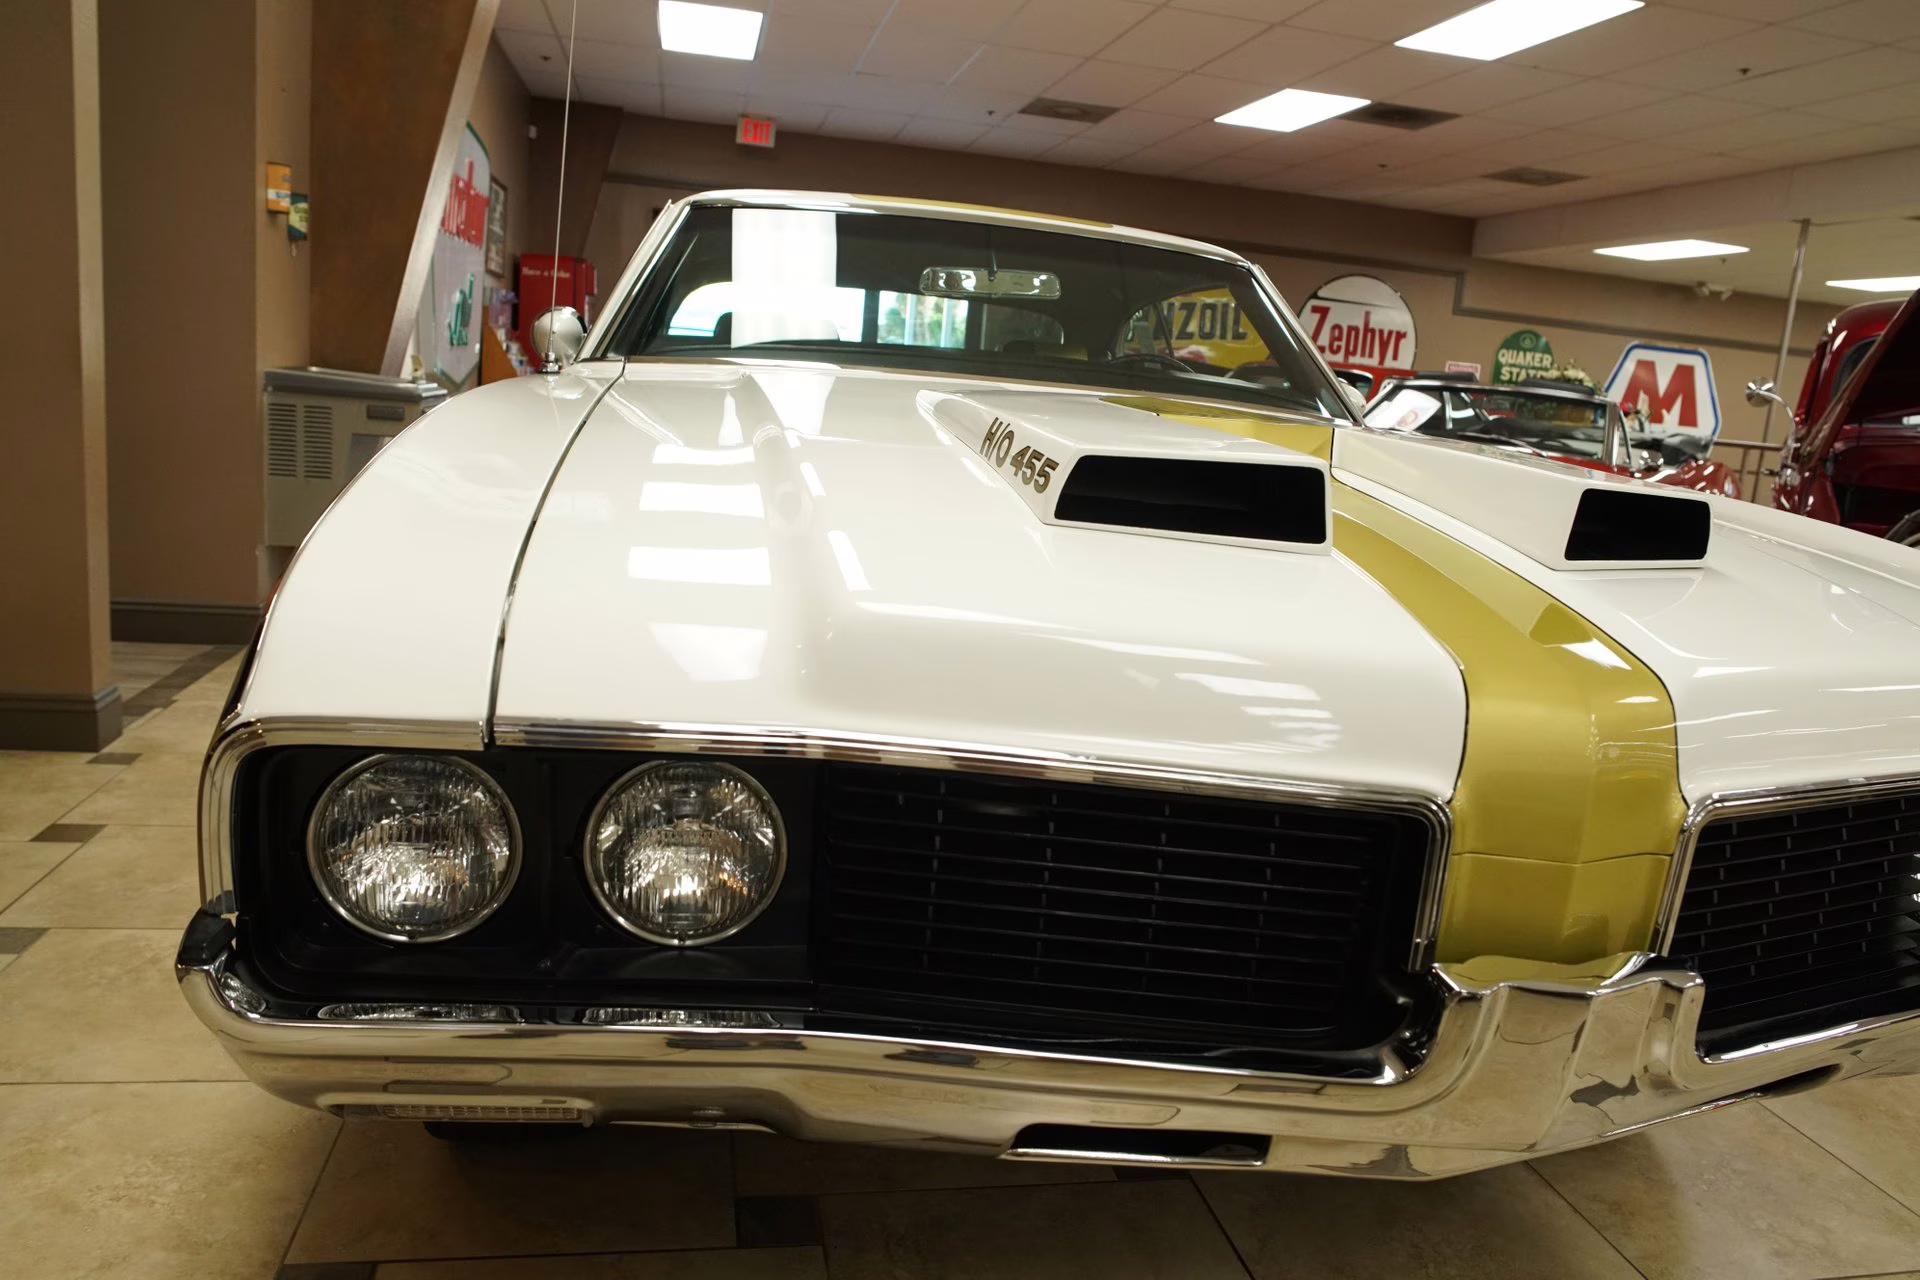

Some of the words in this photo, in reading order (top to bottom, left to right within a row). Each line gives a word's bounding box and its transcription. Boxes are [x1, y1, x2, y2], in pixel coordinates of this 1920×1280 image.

[742, 119, 772, 144] EXIT
[1310, 303, 1408, 366] Zephyr
[1498, 348, 1553, 369] QUAKER
[1621, 358, 1699, 428] M
[979, 416, 1015, 469] H/O
[1009, 445, 1060, 494] 455
